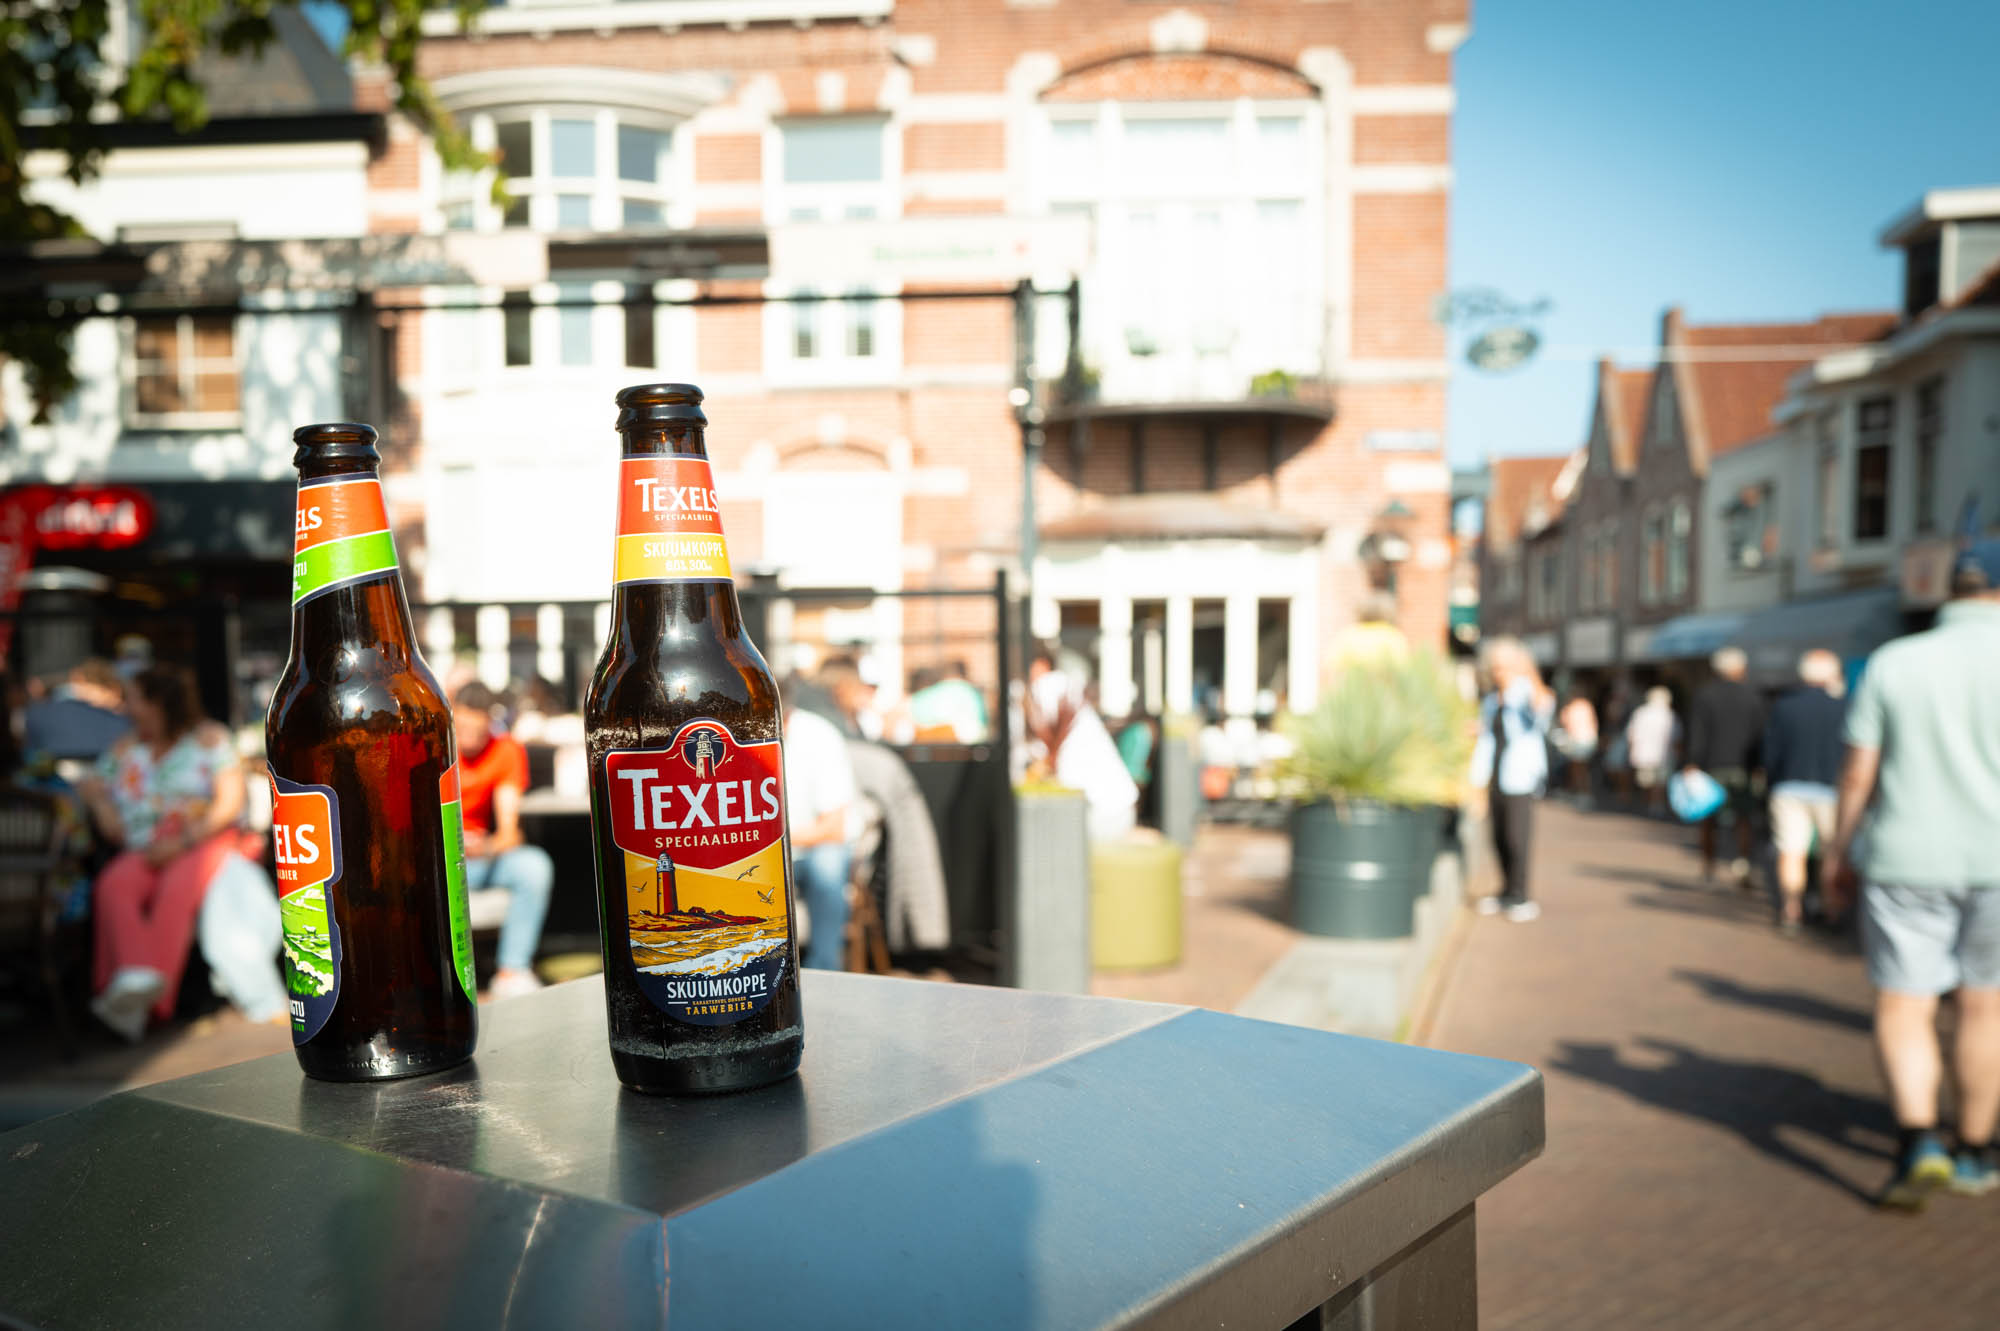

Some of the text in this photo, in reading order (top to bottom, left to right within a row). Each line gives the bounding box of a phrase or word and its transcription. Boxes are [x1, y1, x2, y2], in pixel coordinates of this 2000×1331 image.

[653, 513, 713, 521] SPECIAALBIER
[654, 829, 761, 849] SPECIAALBIER
[685, 1001, 753, 1016] TARWEBIER
